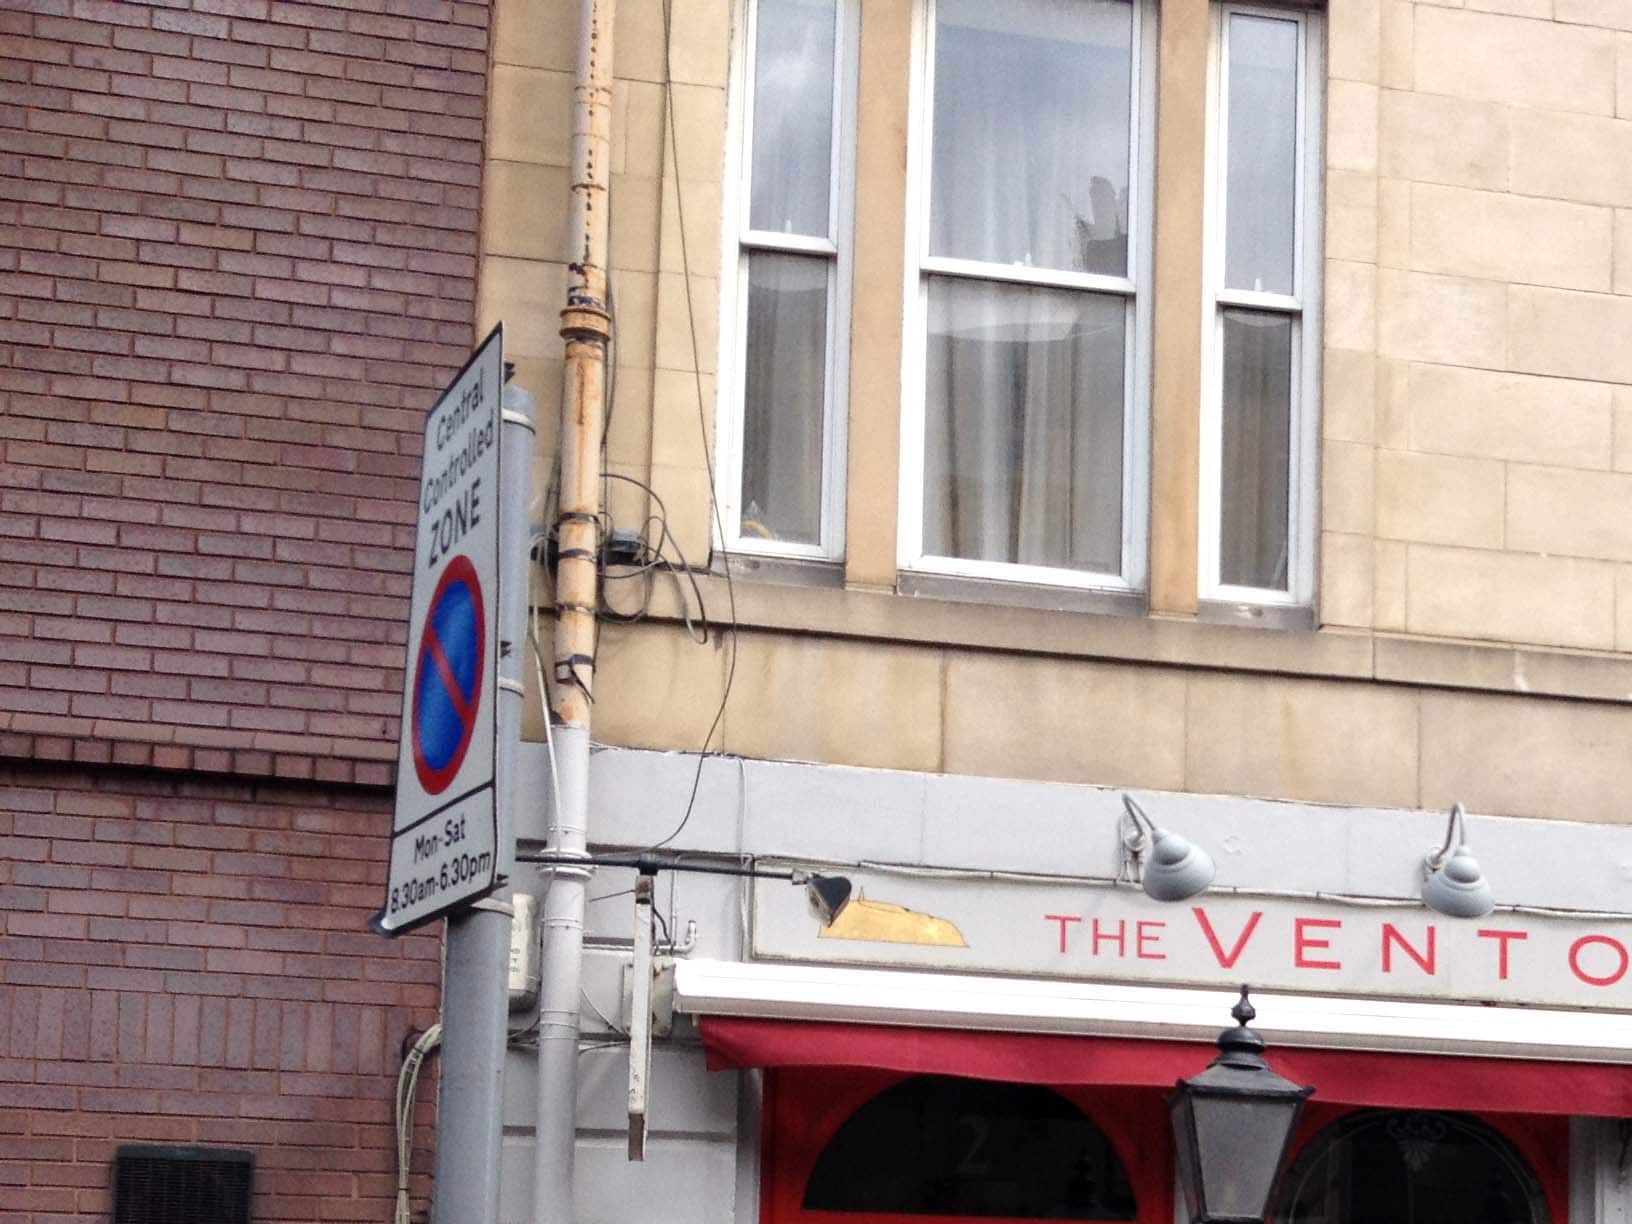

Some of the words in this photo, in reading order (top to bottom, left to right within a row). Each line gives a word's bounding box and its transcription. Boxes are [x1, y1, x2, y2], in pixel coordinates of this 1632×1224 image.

[436, 368, 484, 451] Central
[423, 407, 494, 515] Controlled
[428, 478, 481, 569] ZONE
[414, 813, 466, 864] Mon-Sat
[391, 852, 491, 914] 8.30am-6.30pm
[1044, 914, 1167, 960] THE
